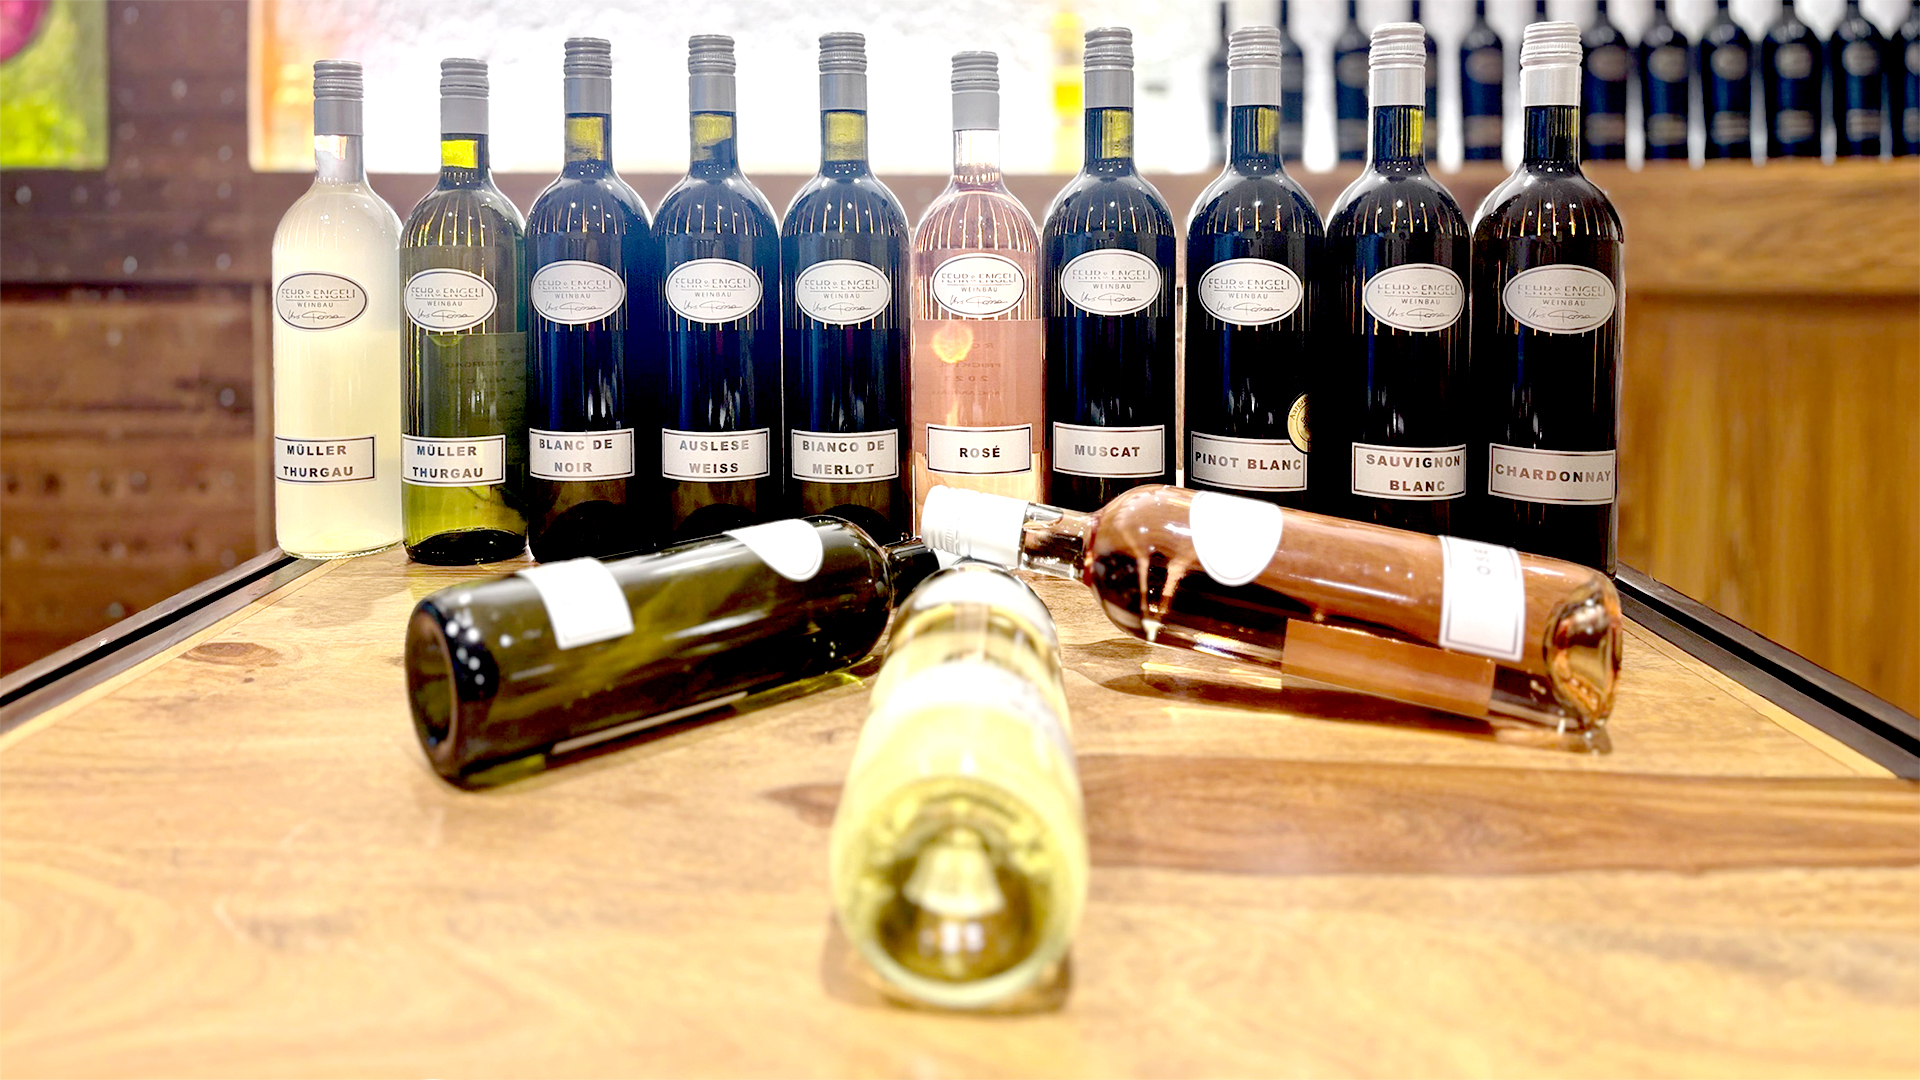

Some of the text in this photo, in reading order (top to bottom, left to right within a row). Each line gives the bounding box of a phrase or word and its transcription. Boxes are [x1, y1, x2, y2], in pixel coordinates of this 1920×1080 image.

[287, 444, 347, 456] MÜLLER
[540, 439, 613, 450] BLANC DE
[679, 440, 750, 451] AUSLESE
[803, 440, 885, 453] BIANCO DE
[417, 445, 477, 457] MÜLLER
[960, 446, 1000, 458] ROSÉ
[1075, 445, 1140, 457] MUSCAT
[1195, 452, 1301, 471] PINOT BLANC
[1366, 454, 1460, 468] SAUVIGNON
[284, 466, 353, 477] THURGAU
[413, 467, 483, 478] THURGAU
[555, 462, 592, 473] NOIR
[690, 463, 738, 474] WEISS
[813, 464, 874, 475] MERLOT
[1496, 464, 1611, 482] CHARDONNAY
[1390, 480, 1445, 491] BLANC
